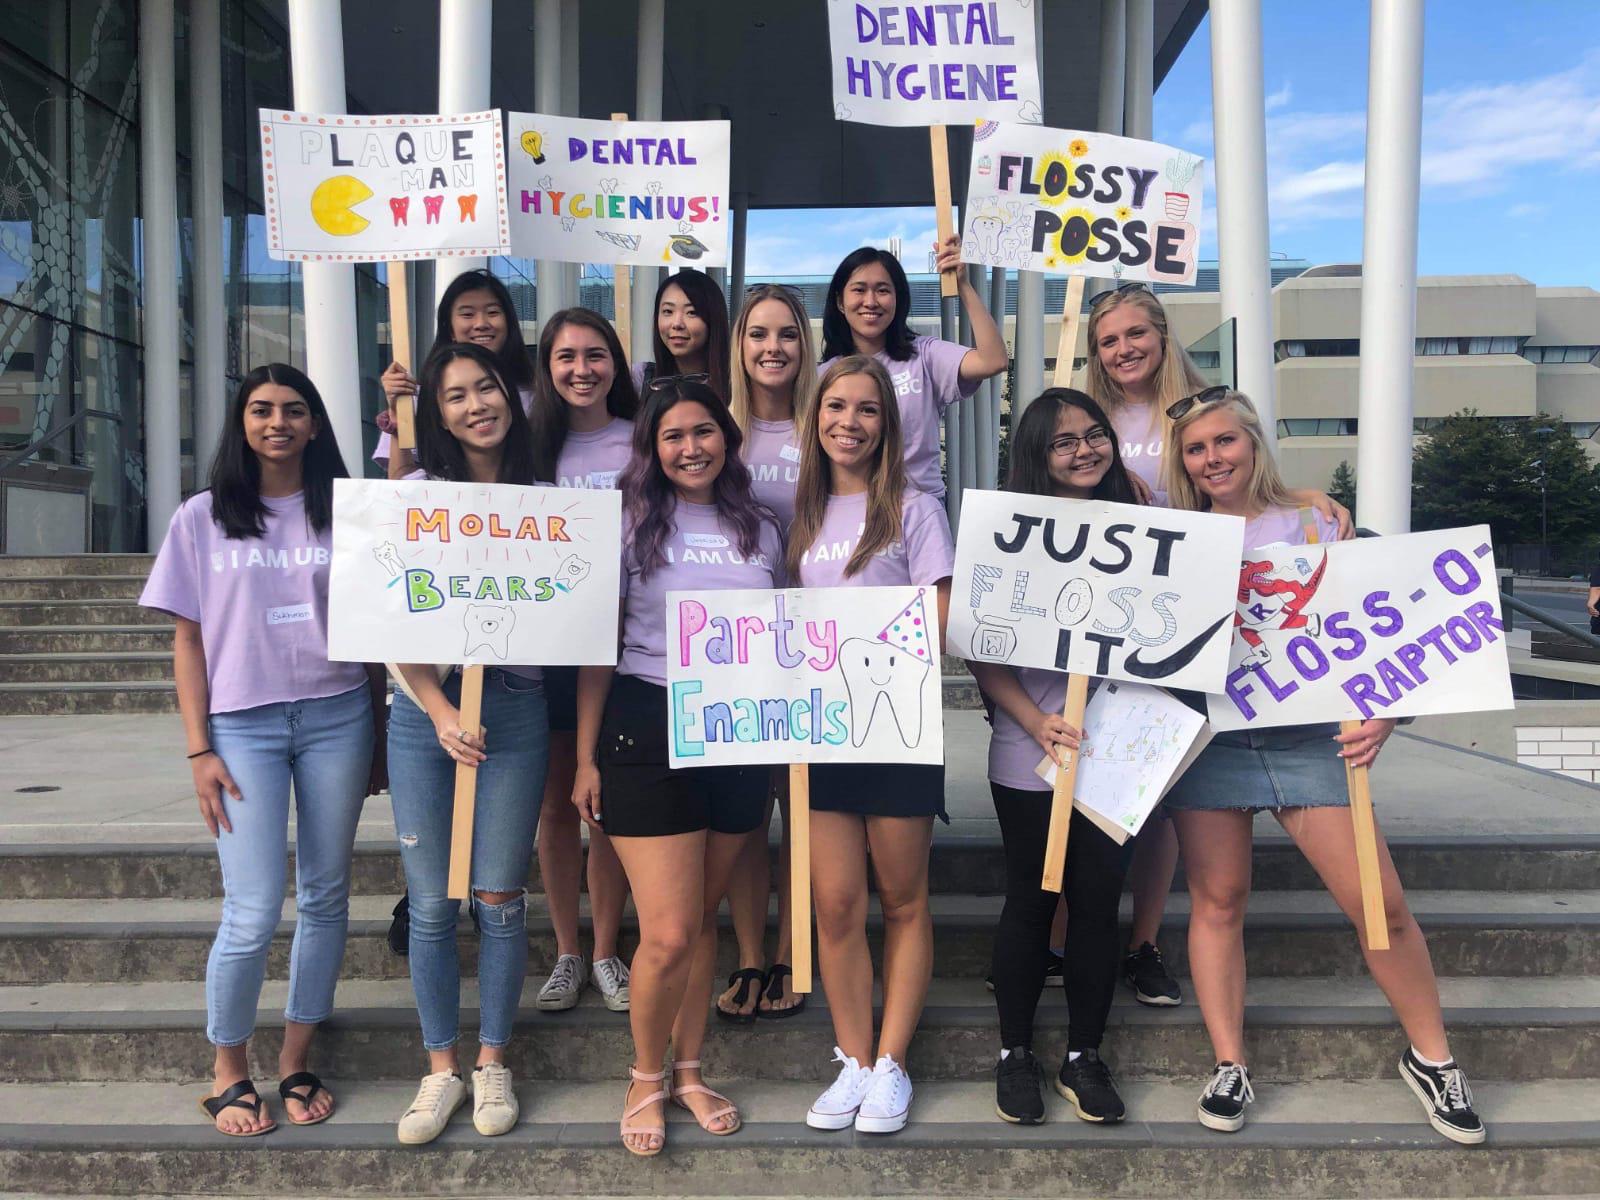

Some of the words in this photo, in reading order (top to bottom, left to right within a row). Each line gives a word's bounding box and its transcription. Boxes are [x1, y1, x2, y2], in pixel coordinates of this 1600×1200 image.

[855, 2, 1015, 46] DENTAL
[846, 56, 1019, 102] HYGIENE
[300, 130, 474, 167] PLAQUE
[568, 137, 697, 166] DENTAL
[401, 163, 475, 192] MAN
[999, 155, 1158, 209] FLOSSY
[520, 190, 721, 223] HYGIENIUS!
[1031, 210, 1186, 275] POSSE
[406, 508, 571, 544] MOLAR
[993, 512, 1187, 577] JUST
[231, 549, 239, 568] I
[246, 548, 289, 569] AM
[295, 546, 331, 566] UB
[667, 546, 675, 563] I
[682, 548, 724, 564] AM
[814, 540, 850, 564] AM
[405, 568, 555, 613] BEARS
[970, 563, 1181, 648] FLOSS
[679, 594, 839, 672] Party
[1055, 628, 1126, 676] IT
[1341, 600, 1504, 720] RAPTOR
[671, 679, 849, 758] Enamels
